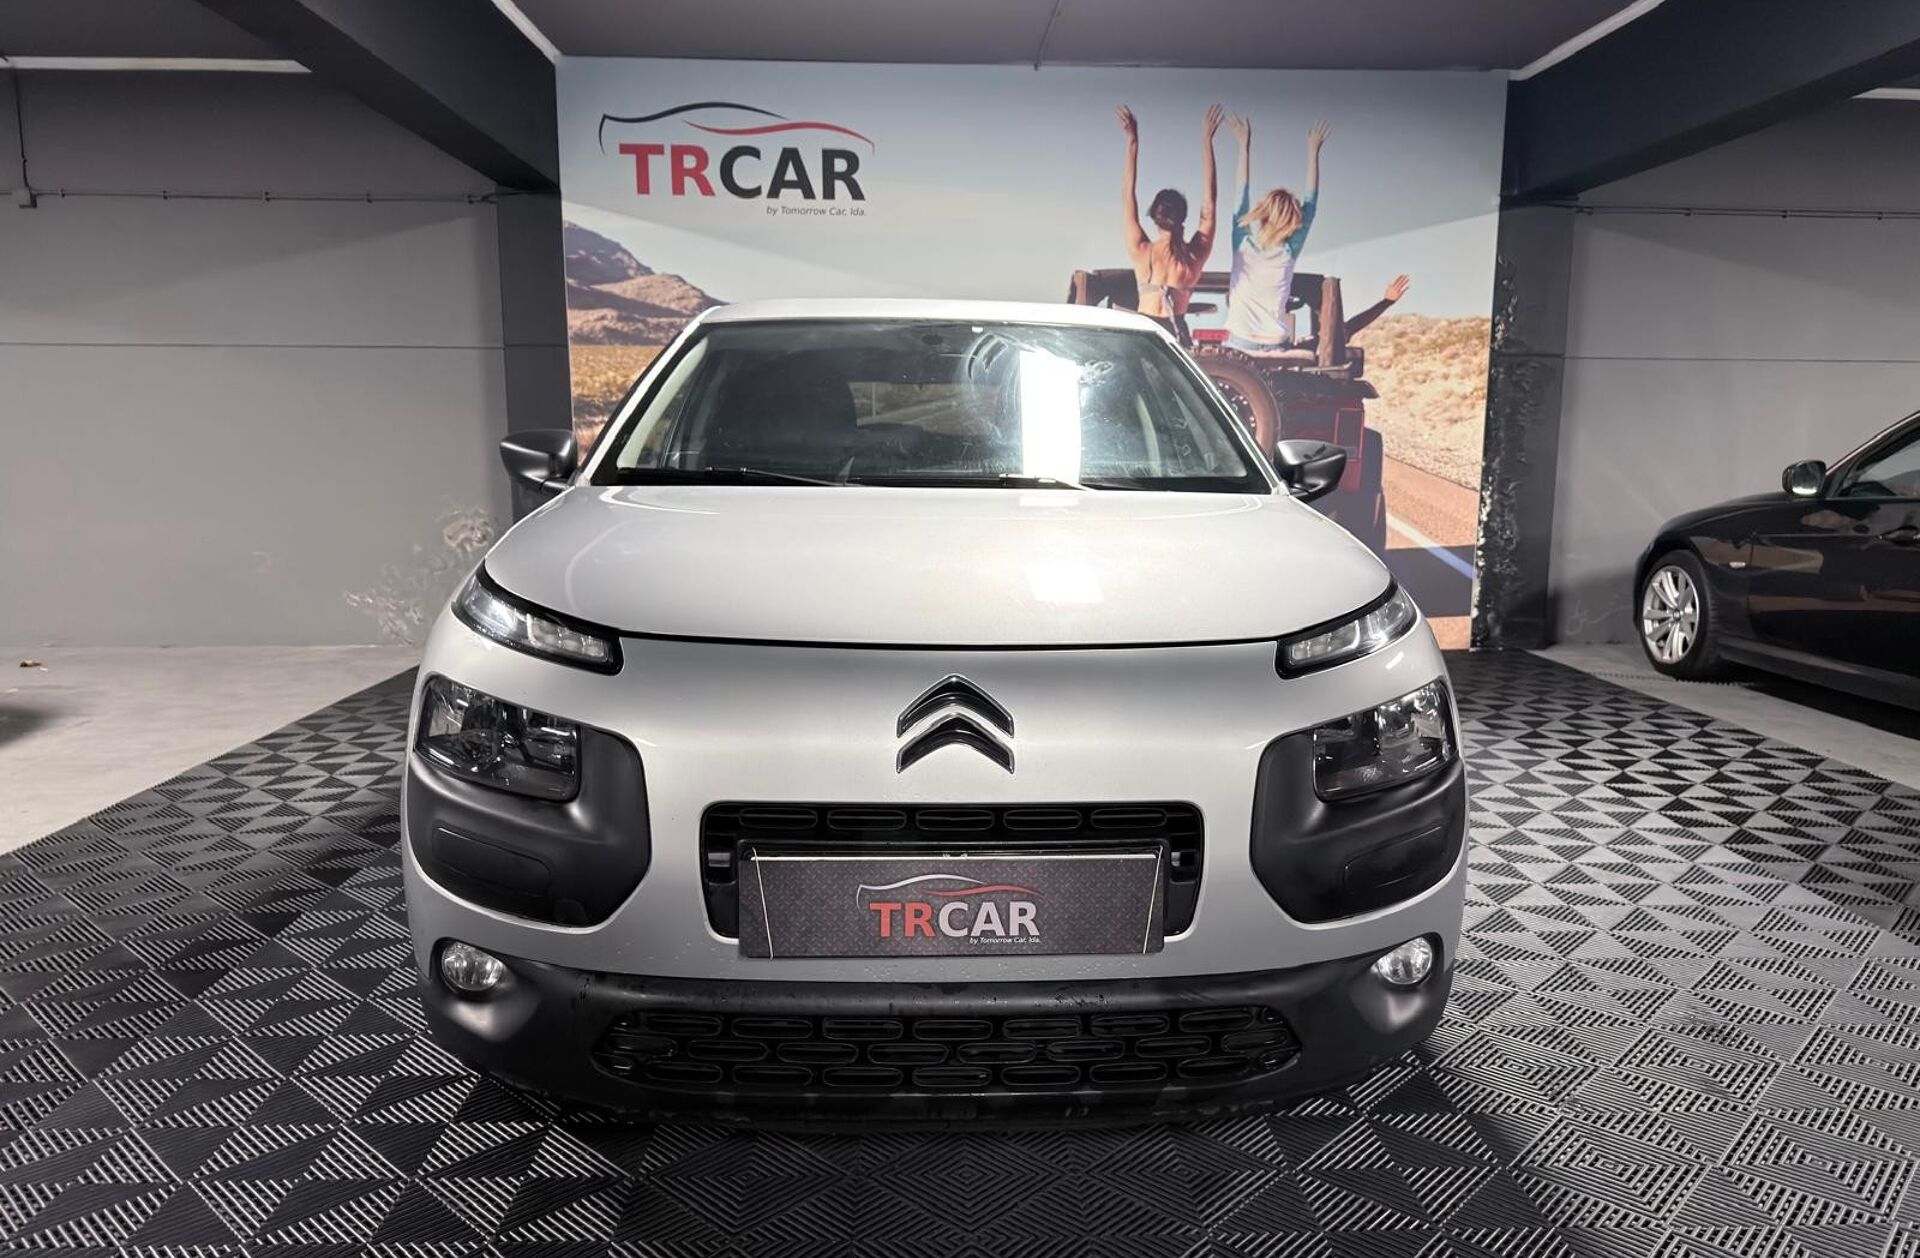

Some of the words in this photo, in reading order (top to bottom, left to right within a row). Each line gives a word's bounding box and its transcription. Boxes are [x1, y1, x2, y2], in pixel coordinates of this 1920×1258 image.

[619, 143, 866, 201] TRCAR
[766, 205, 778, 216] by
[781, 205, 827, 216] Tomorrow
[869, 901, 1040, 938] TRCAR
[969, 937, 979, 945] by
